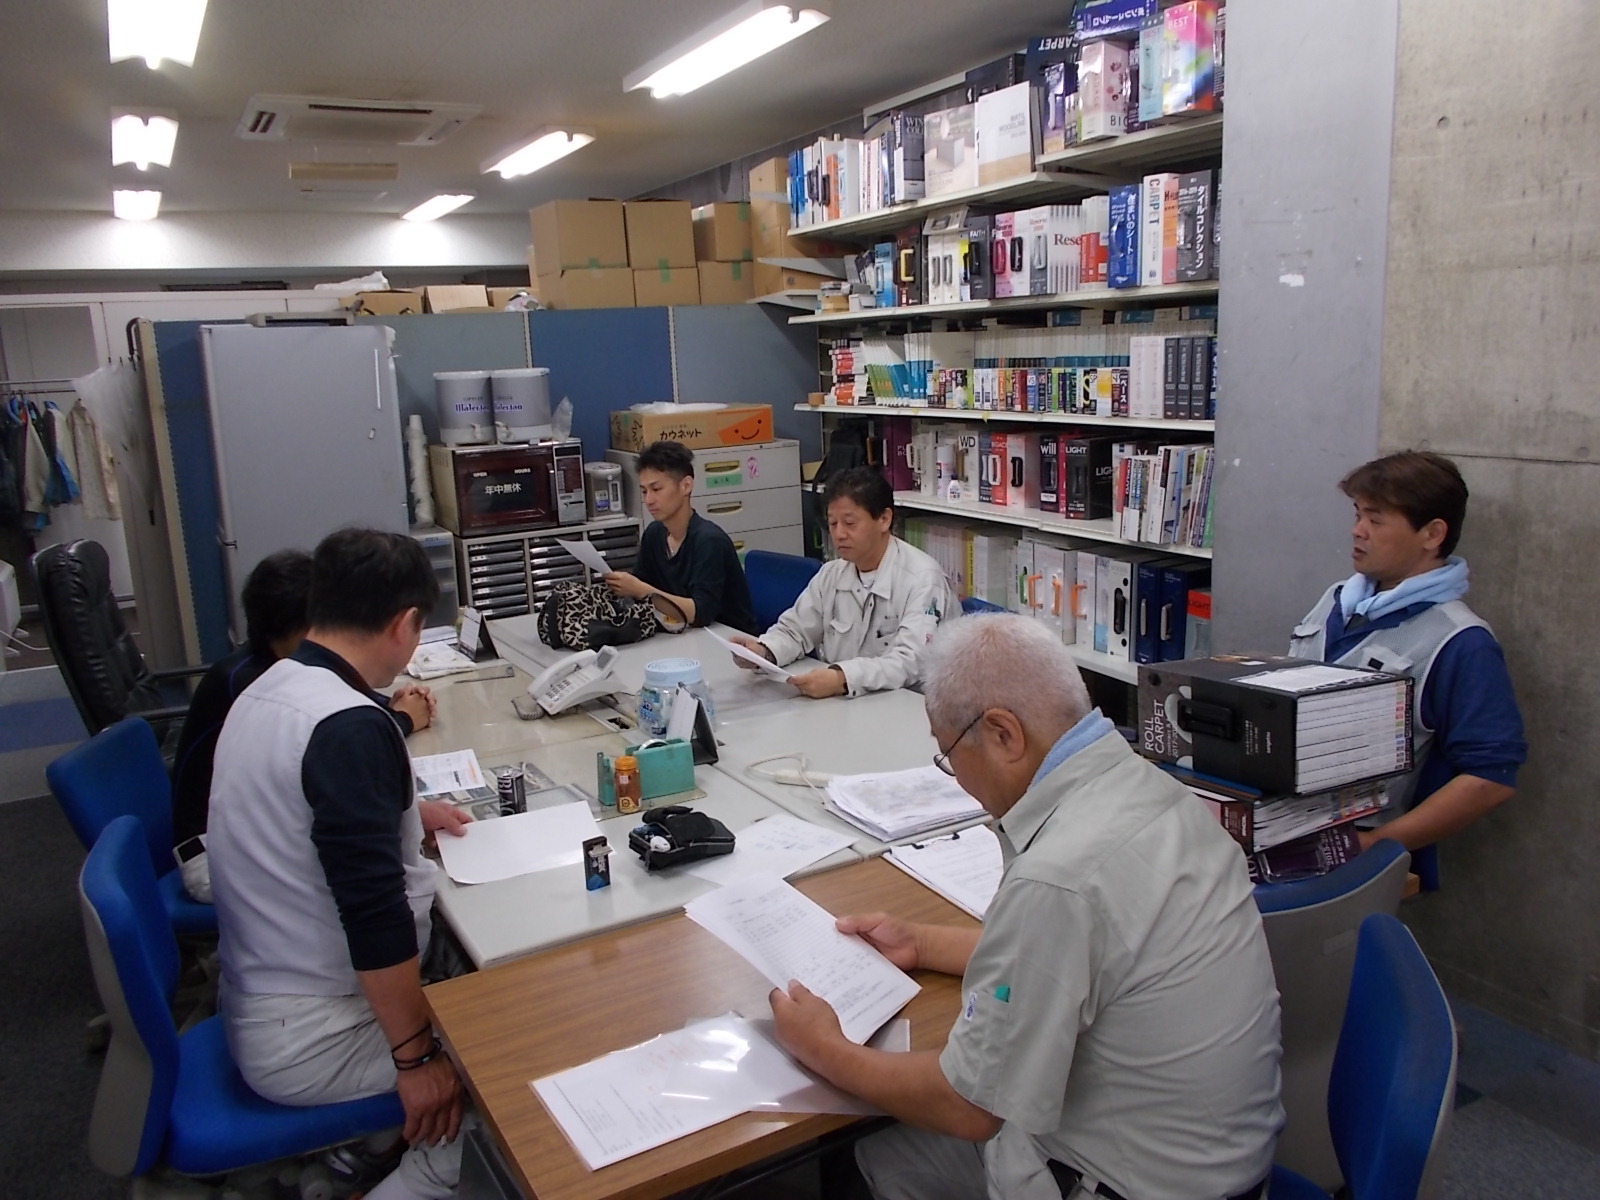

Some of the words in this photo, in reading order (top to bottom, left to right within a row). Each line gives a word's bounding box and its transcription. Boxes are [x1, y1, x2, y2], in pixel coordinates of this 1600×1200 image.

[1168, 15, 1188, 29] BEST
[1148, 178, 1160, 225] CARPET
[969, 229, 986, 238] FAITH
[1195, 185, 1206, 269] タイルコレクション
[1120, 379, 1128, 404] ベース
[659, 428, 702, 441] カウネット
[1040, 442, 1057, 455] will
[1065, 446, 1087, 454] LIGHT
[484, 483, 522, 496] 年中無休
[1153, 698, 1165, 754] CARPET
[1144, 717, 1154, 751] ROLL
